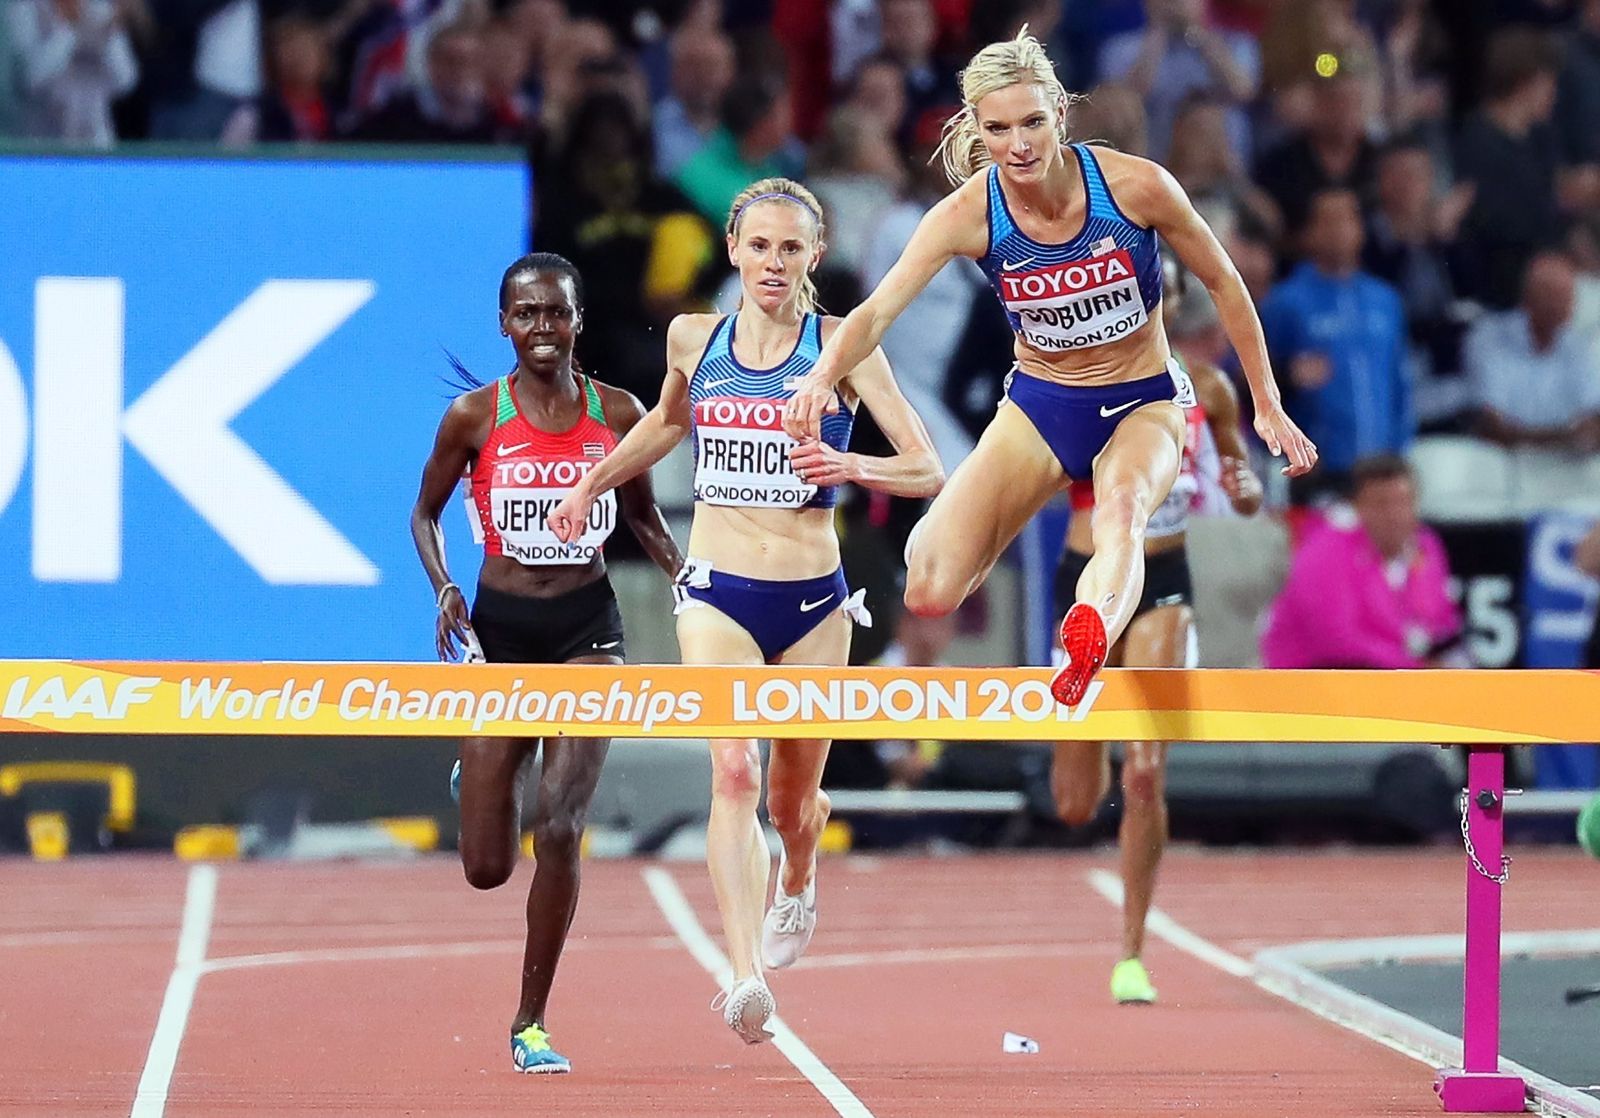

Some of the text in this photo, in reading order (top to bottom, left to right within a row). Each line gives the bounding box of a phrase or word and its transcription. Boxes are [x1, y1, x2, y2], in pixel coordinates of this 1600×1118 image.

[1004, 258, 1128, 298] TOYOTA
[1020, 288, 1132, 330] COBURN
[1028, 311, 1141, 349] LONDON 2017
[0, 275, 381, 586] K
[700, 401, 784, 427] TOYOT
[497, 461, 592, 485] TOYOT
[703, 437, 794, 475] FRERICH
[497, 499, 609, 531] JEPKOI
[771, 489, 811, 503] 2017
[1, 677, 161, 719] IAAF
[179, 678, 324, 721] World
[338, 678, 703, 732] Championships
[733, 680, 967, 721] LONDON
